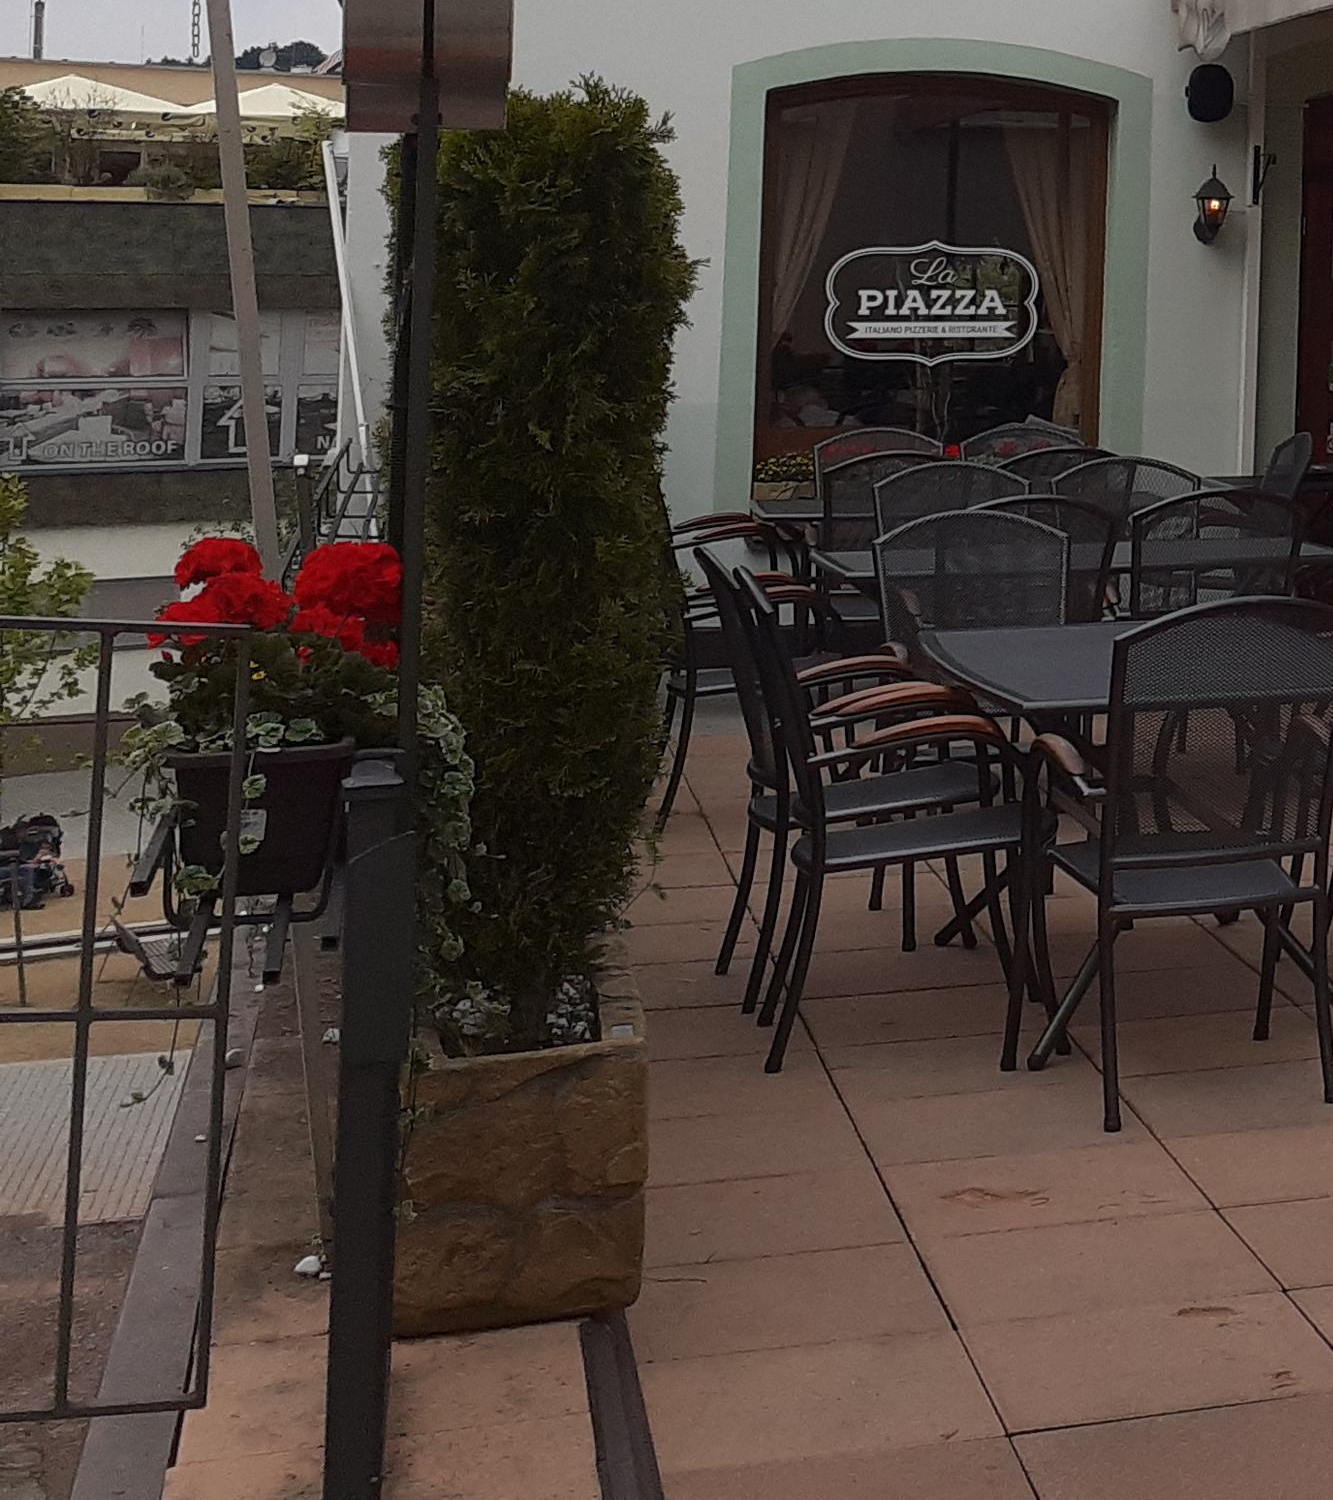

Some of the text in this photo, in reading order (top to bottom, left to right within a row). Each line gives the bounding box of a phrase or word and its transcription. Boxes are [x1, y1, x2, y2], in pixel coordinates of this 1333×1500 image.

[910, 256, 957, 285] La
[857, 289, 1007, 316] PIAZZA
[44, 442, 74, 458] ON
[123, 440, 178, 456] ROOF
